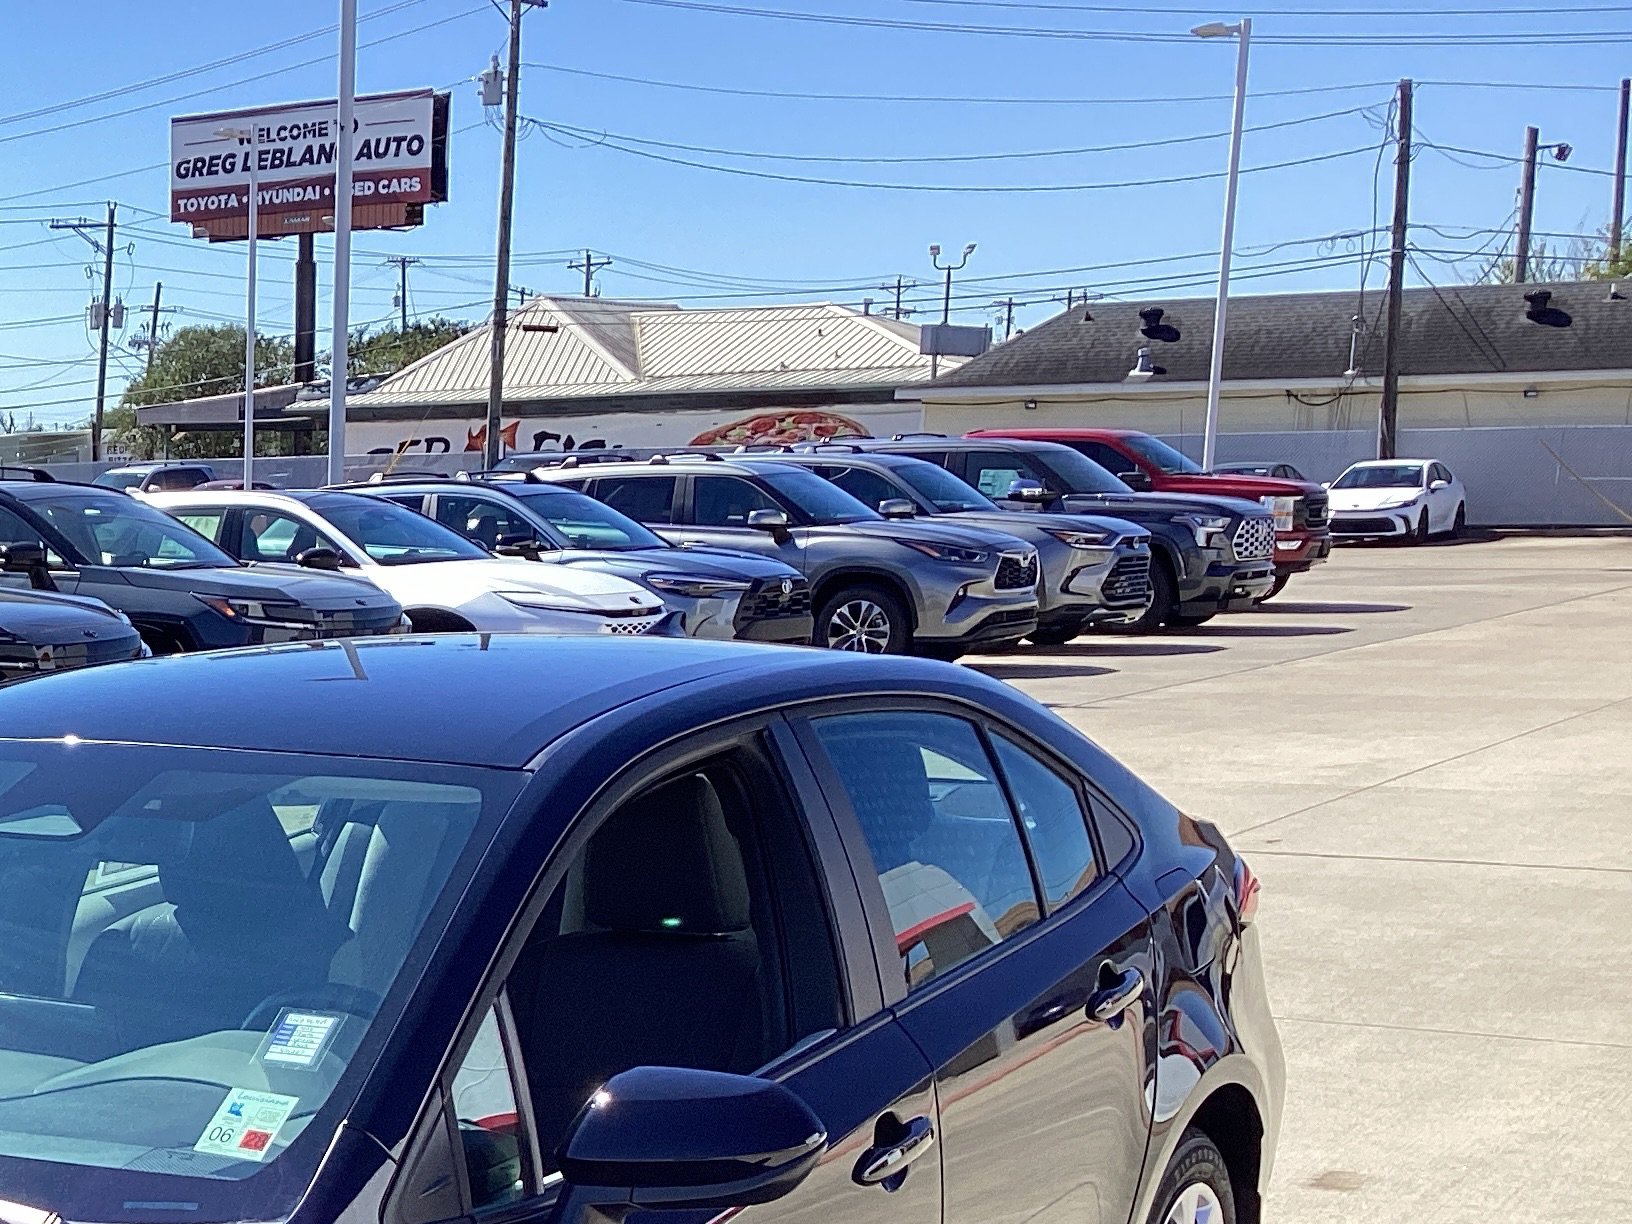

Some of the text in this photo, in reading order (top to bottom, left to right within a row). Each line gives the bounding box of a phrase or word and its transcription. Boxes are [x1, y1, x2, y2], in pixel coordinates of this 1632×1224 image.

[175, 134, 425, 180] GREG LEBLAN AUTO
[177, 177, 422, 214] TOYOTA HYUNDAI SED CARS
[208, 1126, 235, 1143] 06
